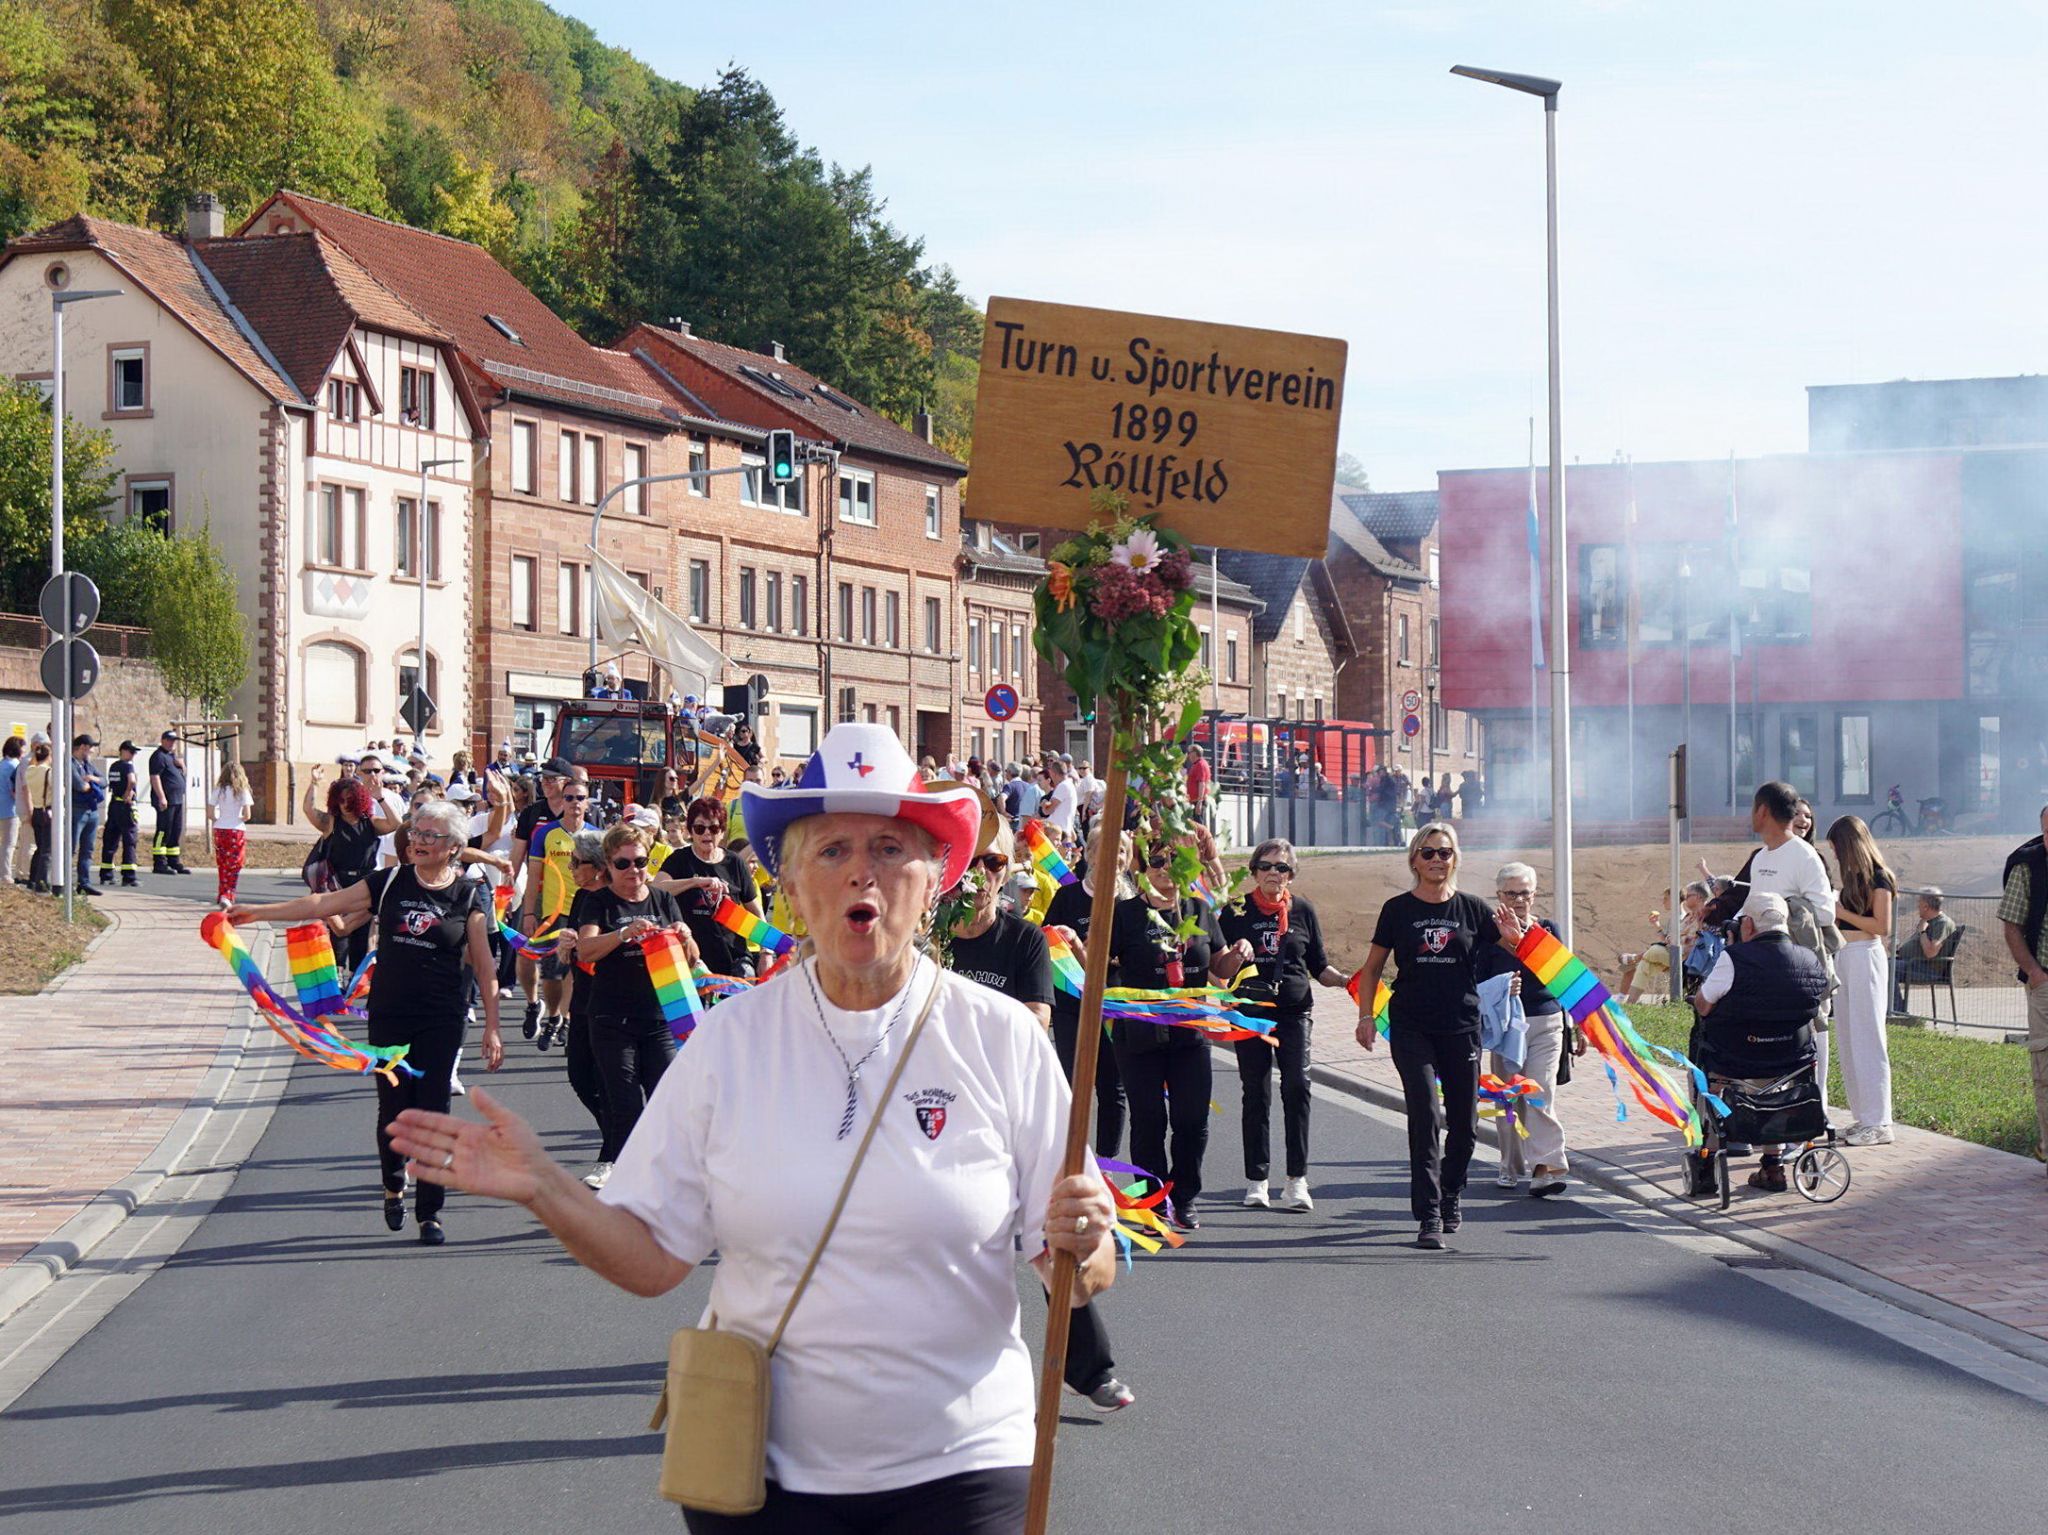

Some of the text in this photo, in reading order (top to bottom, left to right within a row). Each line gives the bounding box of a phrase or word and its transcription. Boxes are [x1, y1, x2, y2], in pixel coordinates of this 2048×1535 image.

[995, 321, 1335, 410] Turn u. Sportverein
[1111, 401, 1198, 447] 1899
[1060, 441, 1228, 507] Röllfeld
[1406, 695, 1417, 707] 50
[919, 1110, 943, 1121] TuS
[926, 1120, 937, 1130] R
